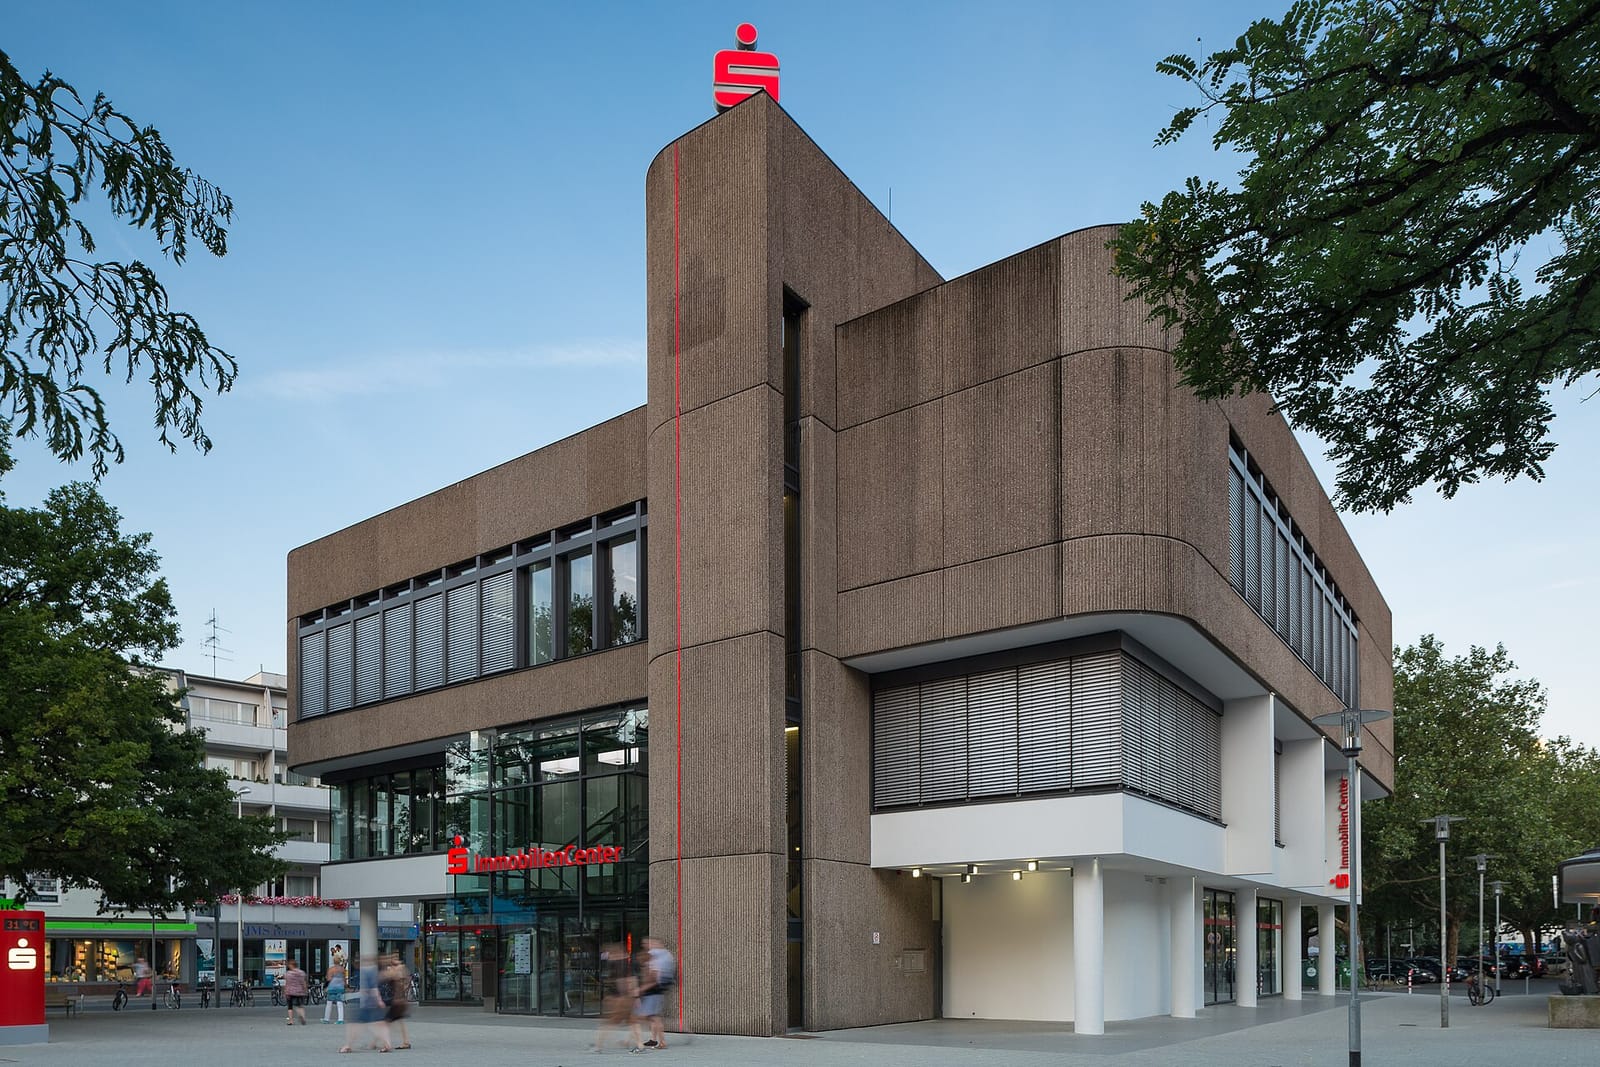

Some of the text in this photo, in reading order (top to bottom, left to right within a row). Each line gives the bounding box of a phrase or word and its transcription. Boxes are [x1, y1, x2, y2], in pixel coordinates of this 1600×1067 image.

[1337, 774, 1349, 870] ImmobilienCenter
[474, 843, 624, 873] ImmobilienCenter
[7, 920, 19, 929] 31
[244, 925, 270, 937] JMS
